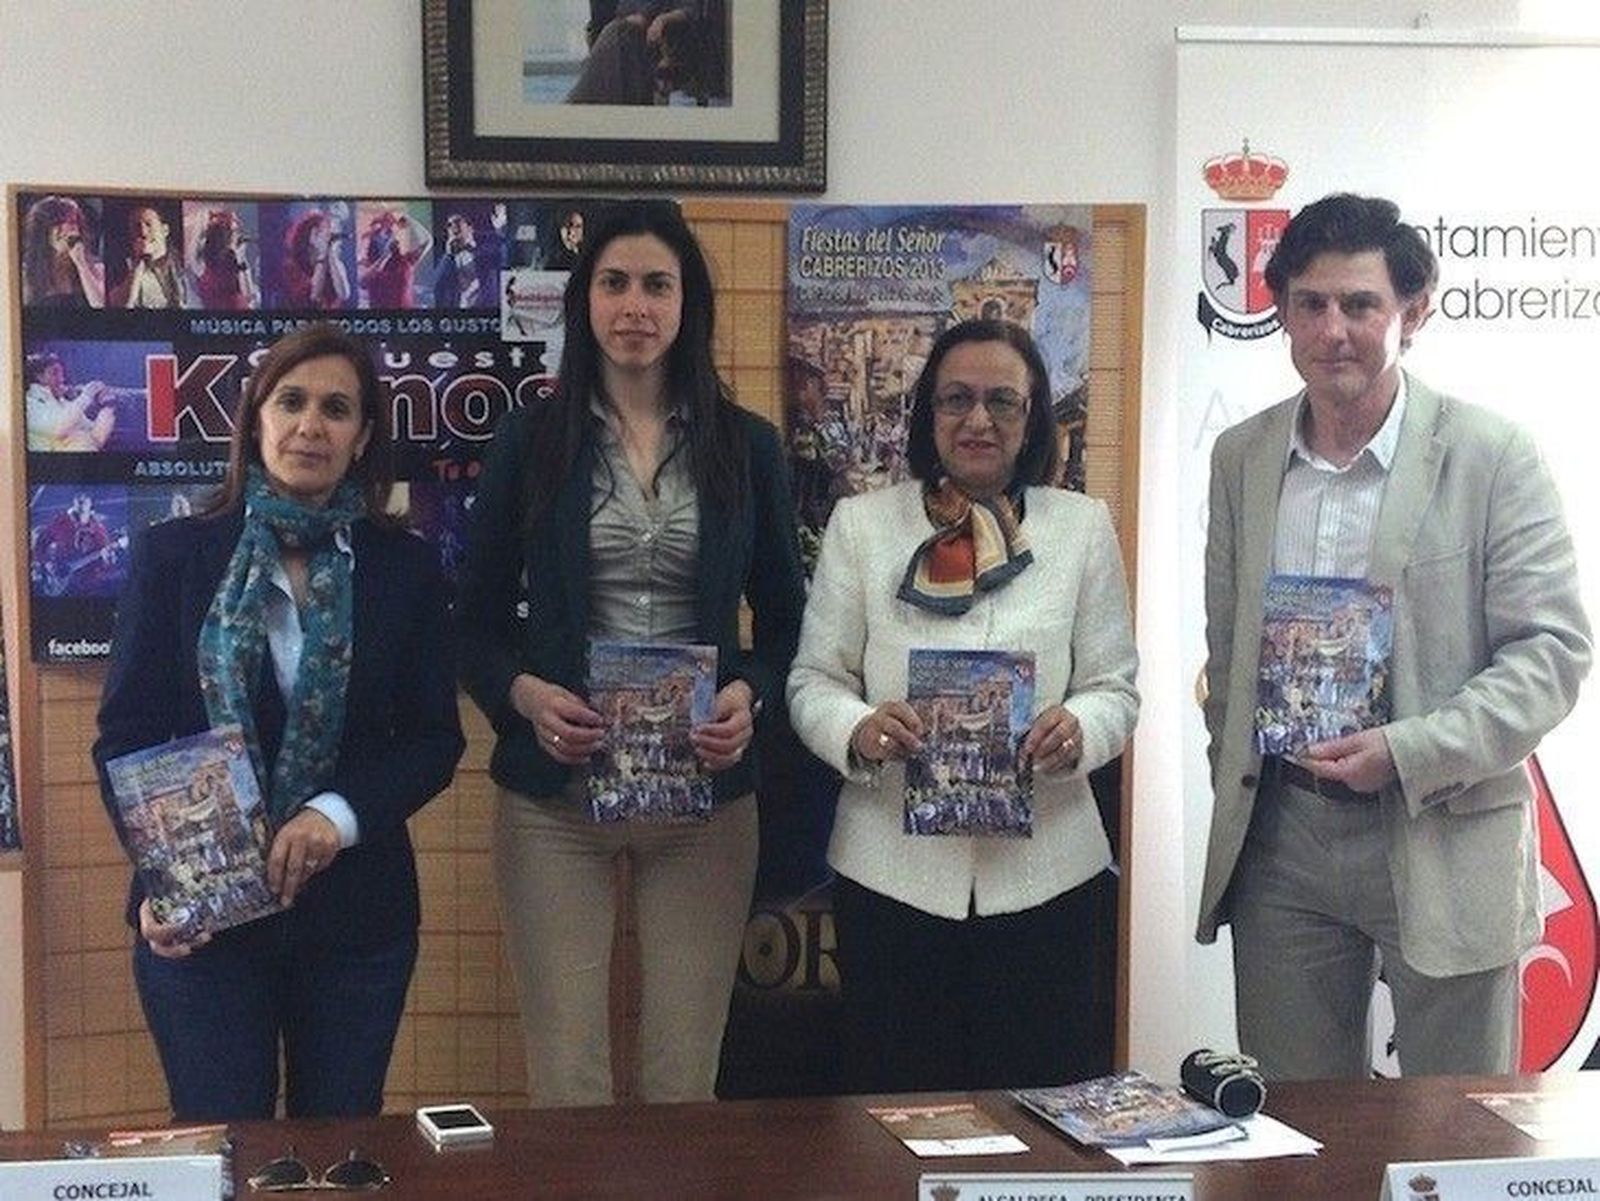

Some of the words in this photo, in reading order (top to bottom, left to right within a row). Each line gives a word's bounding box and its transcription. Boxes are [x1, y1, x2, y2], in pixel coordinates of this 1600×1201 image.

[802, 226, 862, 253] Fiestas
[865, 228, 893, 252] del
[896, 226, 946, 252] Señor
[1412, 216, 1600, 258] ntamien
[801, 257, 905, 279] CABRERIZOS
[909, 257, 947, 280] 2013
[1428, 277, 1600, 321] abreriz
[271, 319, 320, 334] PAR
[328, 318, 392, 334] ODOS
[398, 318, 433, 334] LOS
[439, 318, 501, 334] GUSTO
[134, 461, 232, 477] ABSOLUT
[48, 638, 113, 656] faceboo
[53, 1182, 152, 1200] CONCEJAL
[1506, 1178, 1598, 1198] CONCEJAL
